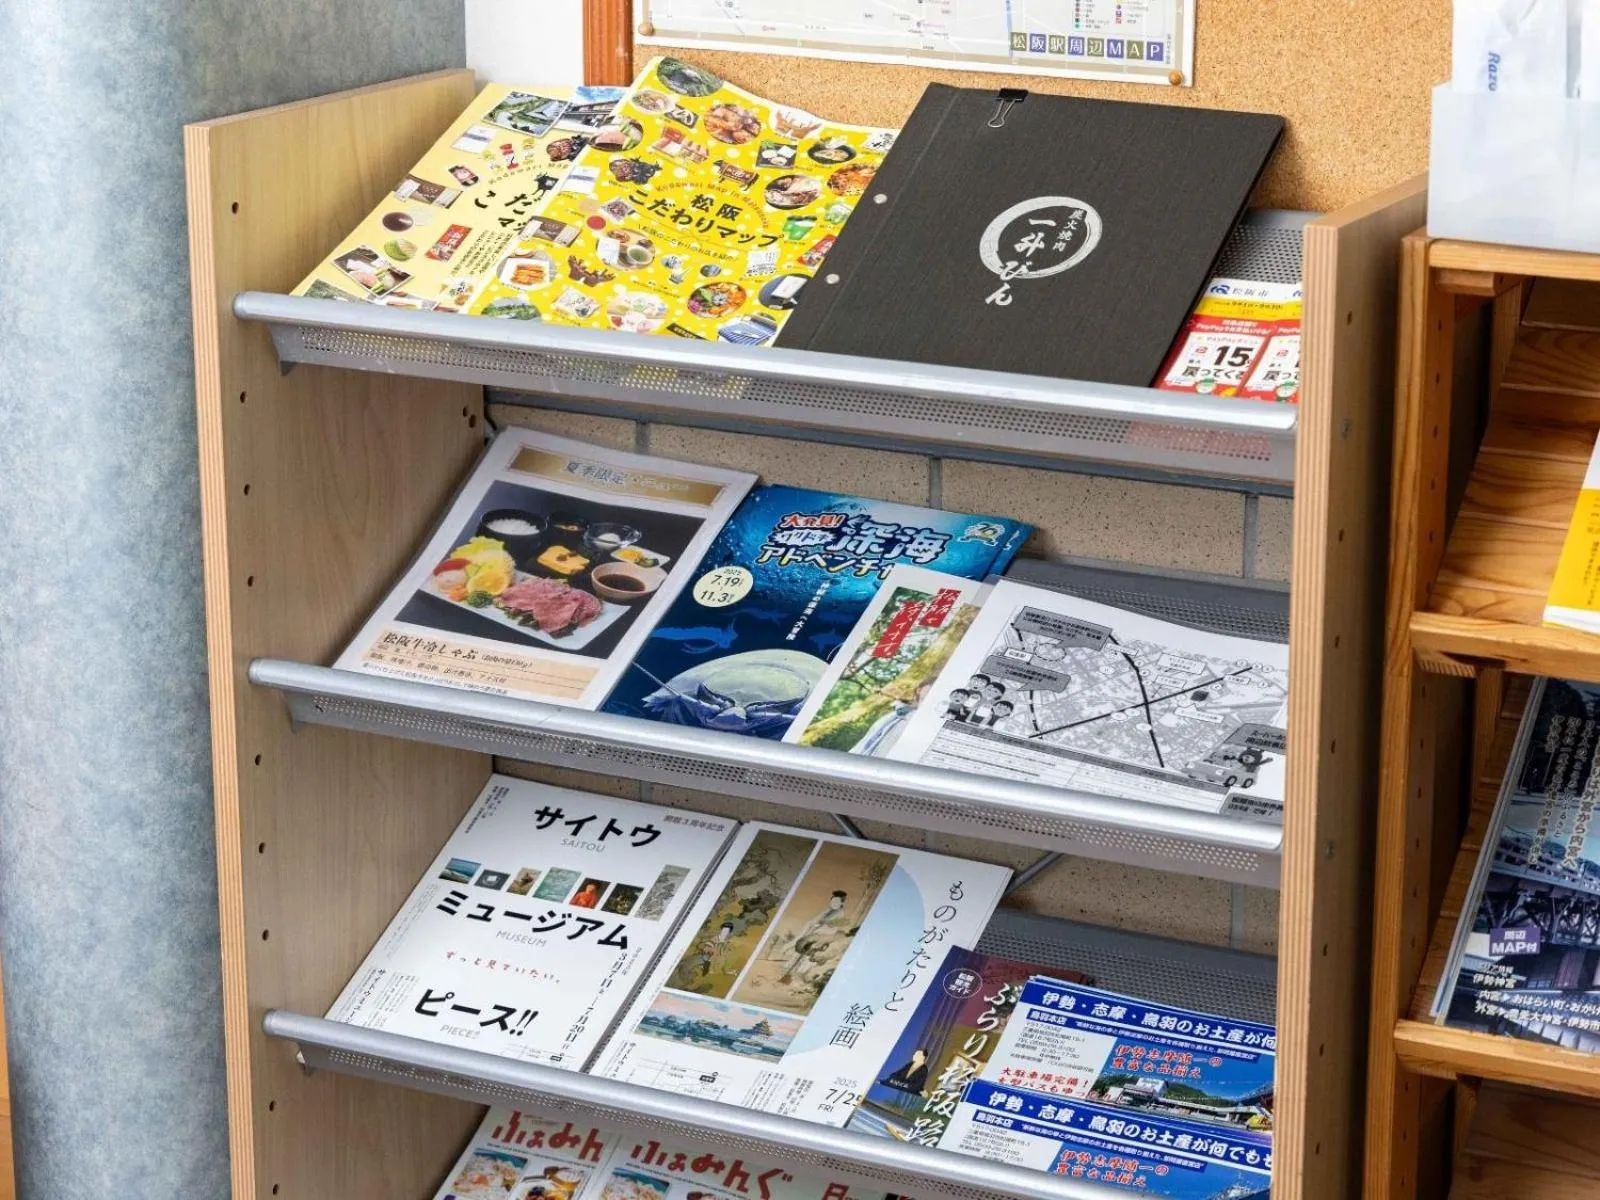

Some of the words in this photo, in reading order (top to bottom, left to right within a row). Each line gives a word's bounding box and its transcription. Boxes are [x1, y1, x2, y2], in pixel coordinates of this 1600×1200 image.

[628, 189, 785, 248] こだわりマップ
[690, 193, 743, 222] 松阪
[826, 514, 953, 564] 深海
[534, 805, 662, 847] サイトウ
[560, 838, 606, 853] SAITOU
[436, 890, 628, 950] ミュージアム
[1504, 929, 1527, 940] 周辺
[496, 930, 547, 948] MUSEUM
[884, 880, 964, 1012] ものがたりと
[1491, 941, 1537, 953] MAP付
[1472, 973, 1517, 989] 伊勢神宮
[829, 1003, 873, 1049] 絵画
[817, 1103, 834, 1112] FRI
